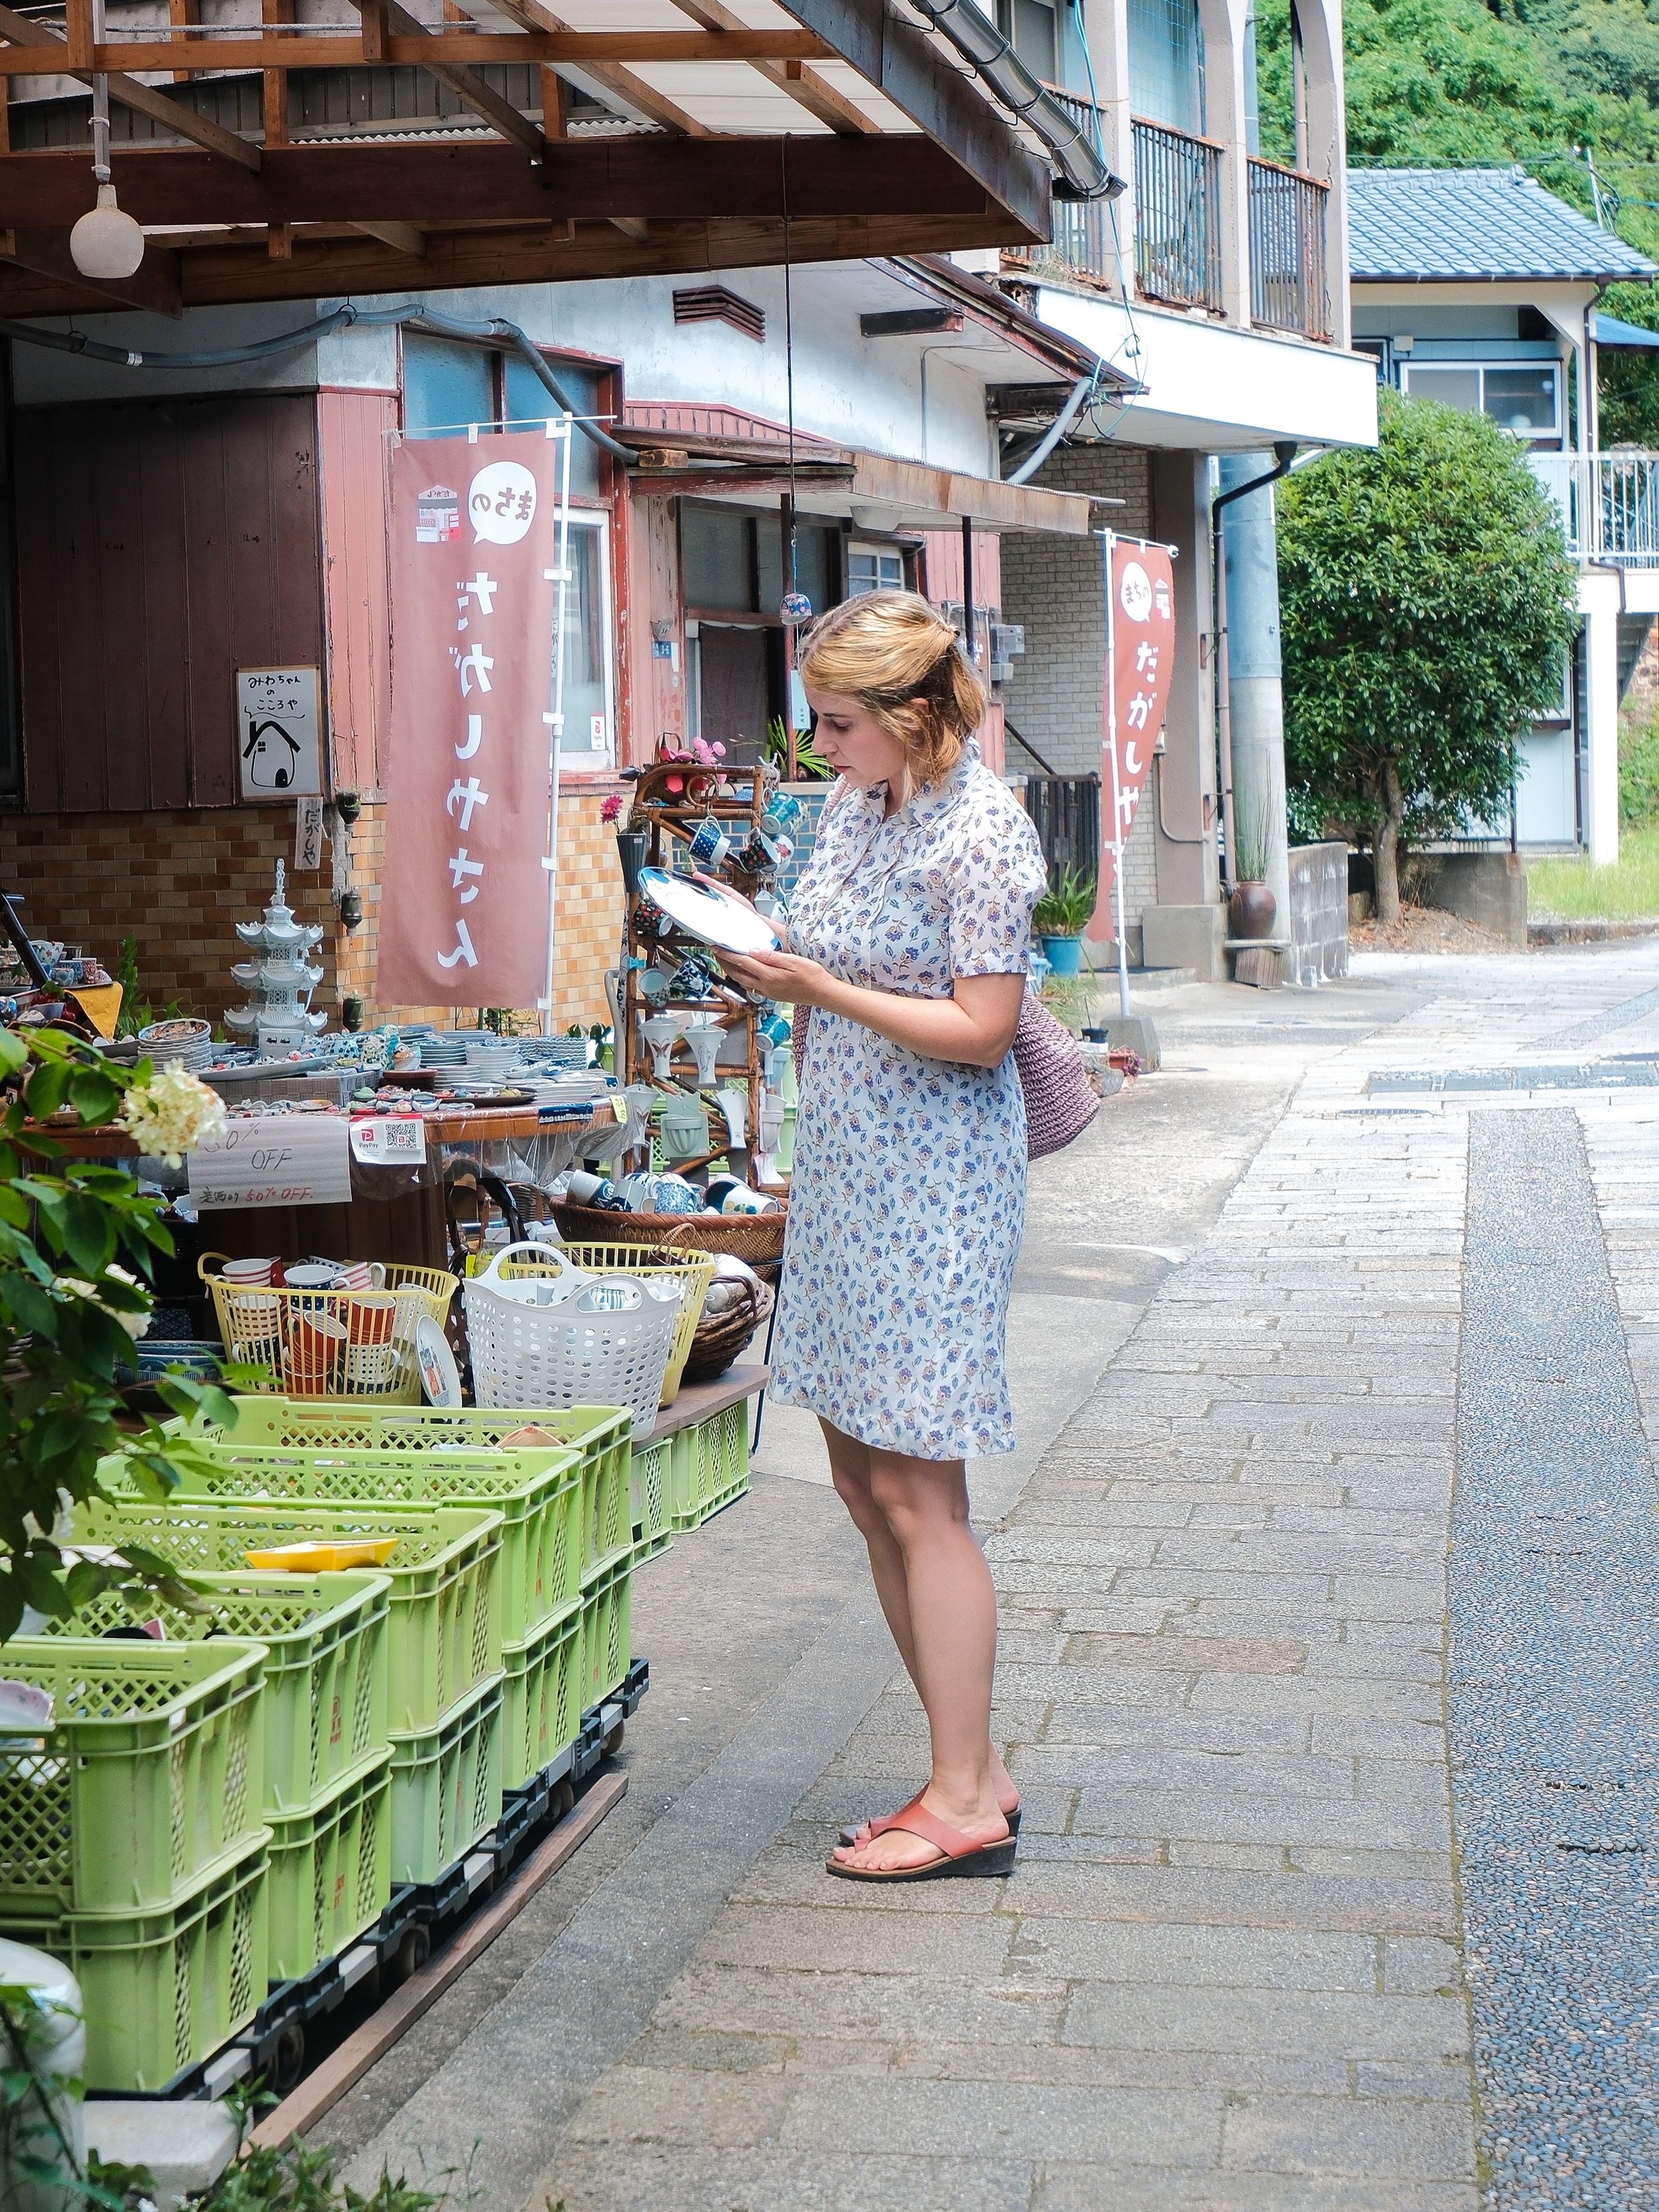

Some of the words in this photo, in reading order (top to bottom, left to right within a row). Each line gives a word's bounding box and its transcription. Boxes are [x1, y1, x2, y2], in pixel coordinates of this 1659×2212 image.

[1125, 581, 1149, 604] まちの
[248, 674, 301, 689] みわちゃん
[256, 699, 299, 711] こころや
[303, 808, 321, 865] だがしや
[252, 1149, 293, 1171] OFF
[245, 1186, 277, 1202] 50%
